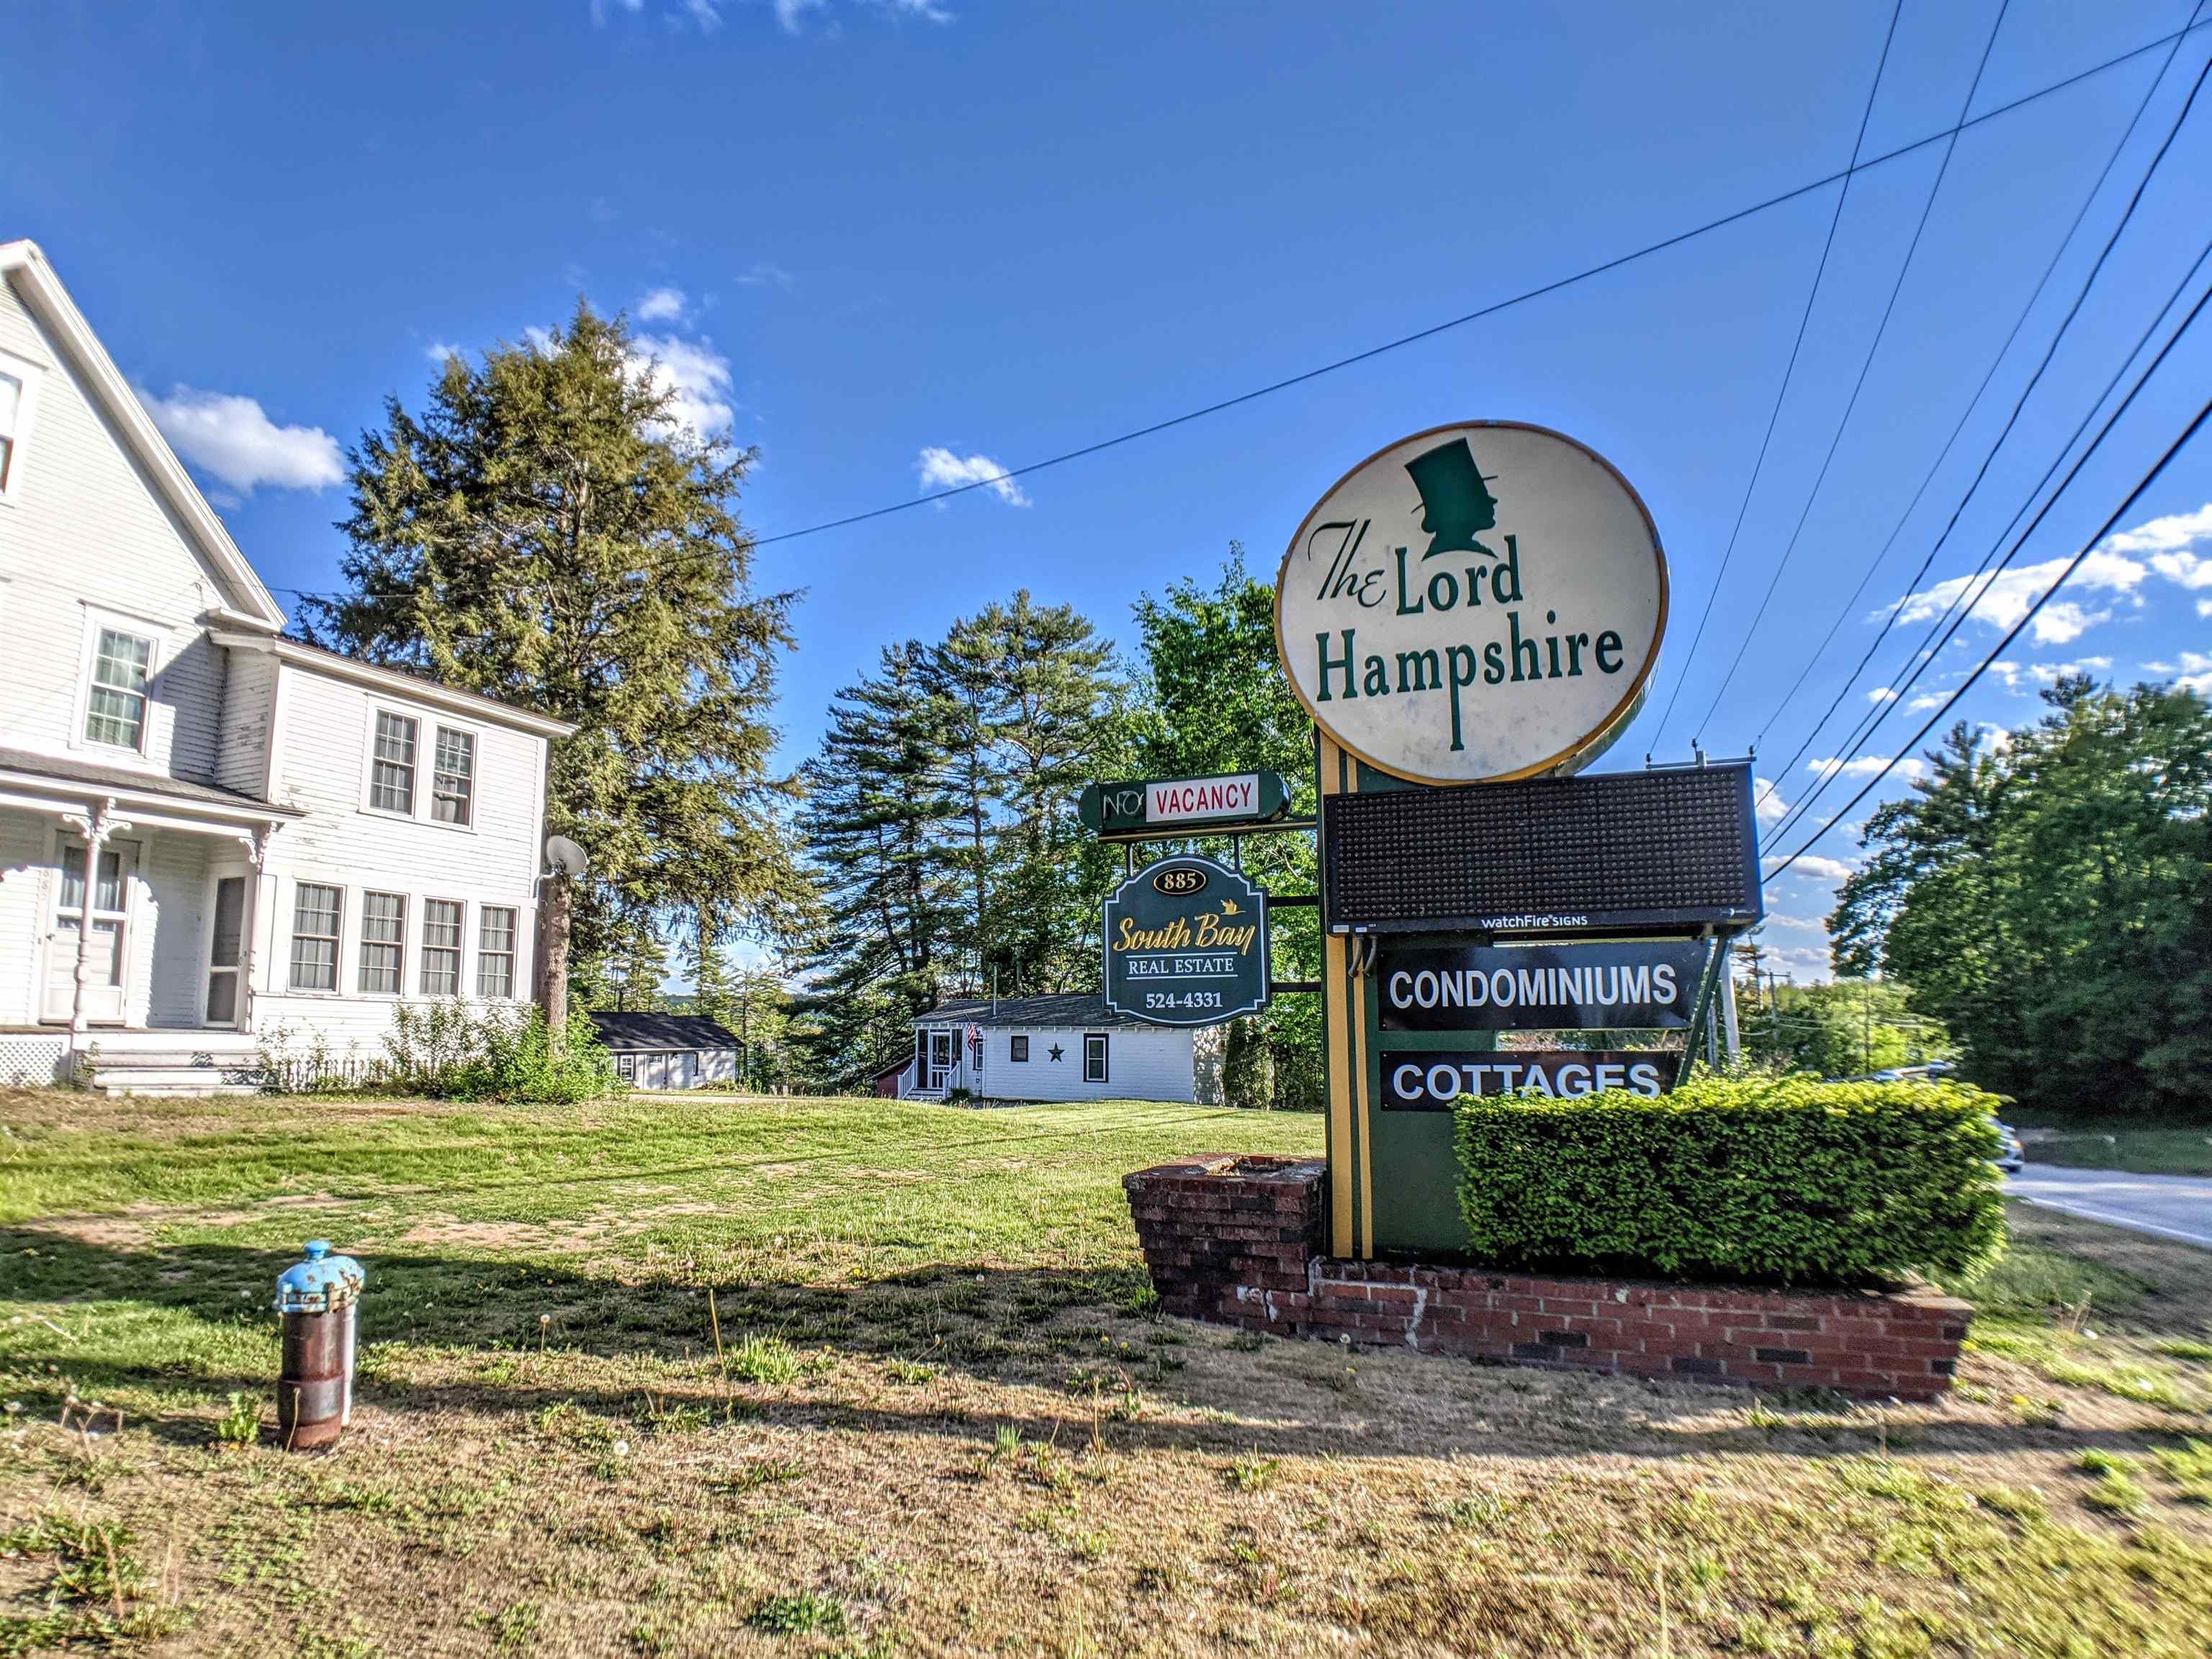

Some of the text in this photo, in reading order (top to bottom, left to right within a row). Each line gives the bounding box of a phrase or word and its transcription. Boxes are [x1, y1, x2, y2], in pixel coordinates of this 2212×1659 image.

[1308, 518, 1523, 616] The Lord
[1316, 611, 1624, 752] Hampshire
[1156, 782, 1251, 814] VACANCY
[1164, 873, 1196, 889] 885
[1112, 913, 1256, 956] South Bay
[1128, 958, 1234, 974] REAL ESTATE
[1146, 992, 1223, 1009] 524-4331
[1389, 963, 1678, 1008] CONDOMINIUMS
[1393, 1064, 1660, 1100] COTTAGES
